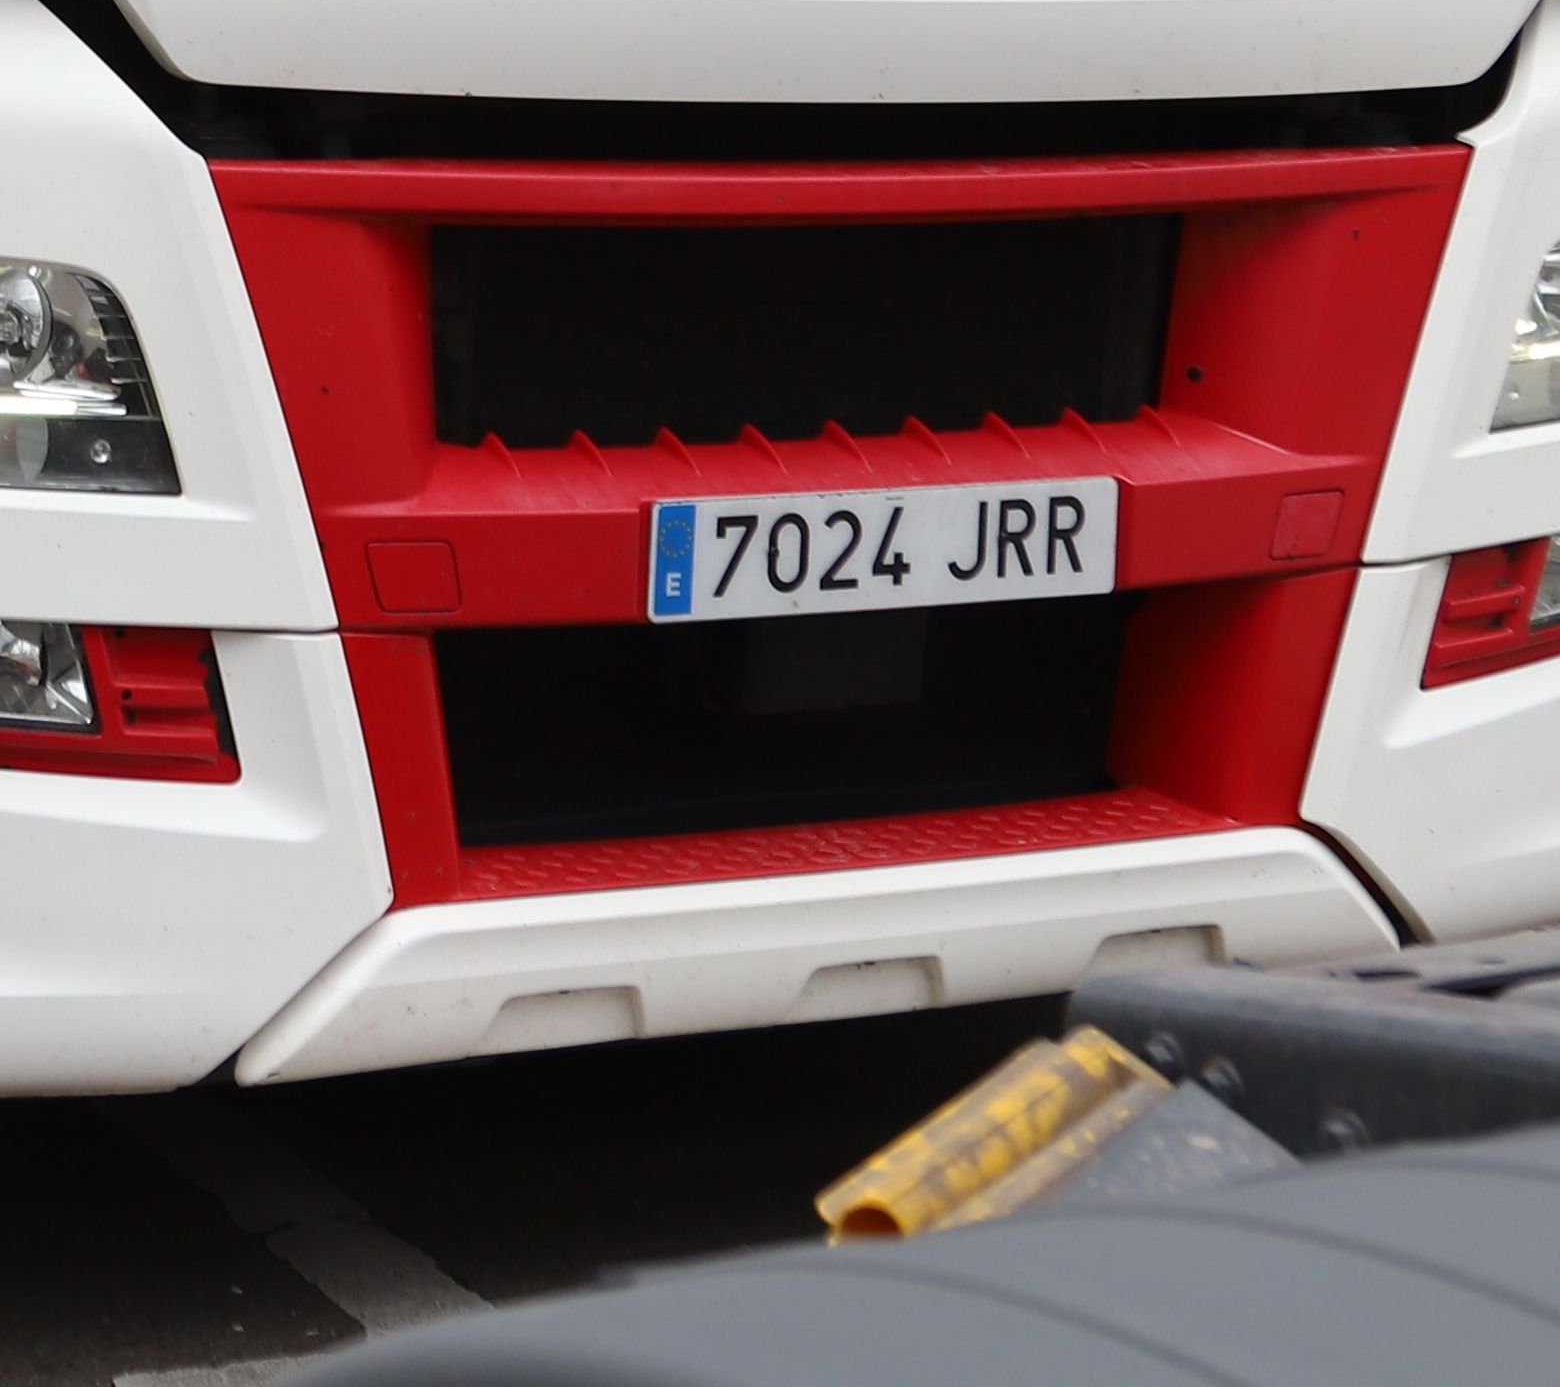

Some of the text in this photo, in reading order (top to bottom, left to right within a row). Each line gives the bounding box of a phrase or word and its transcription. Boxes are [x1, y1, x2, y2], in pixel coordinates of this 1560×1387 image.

[665, 495, 1087, 599] E 7024 JRR
